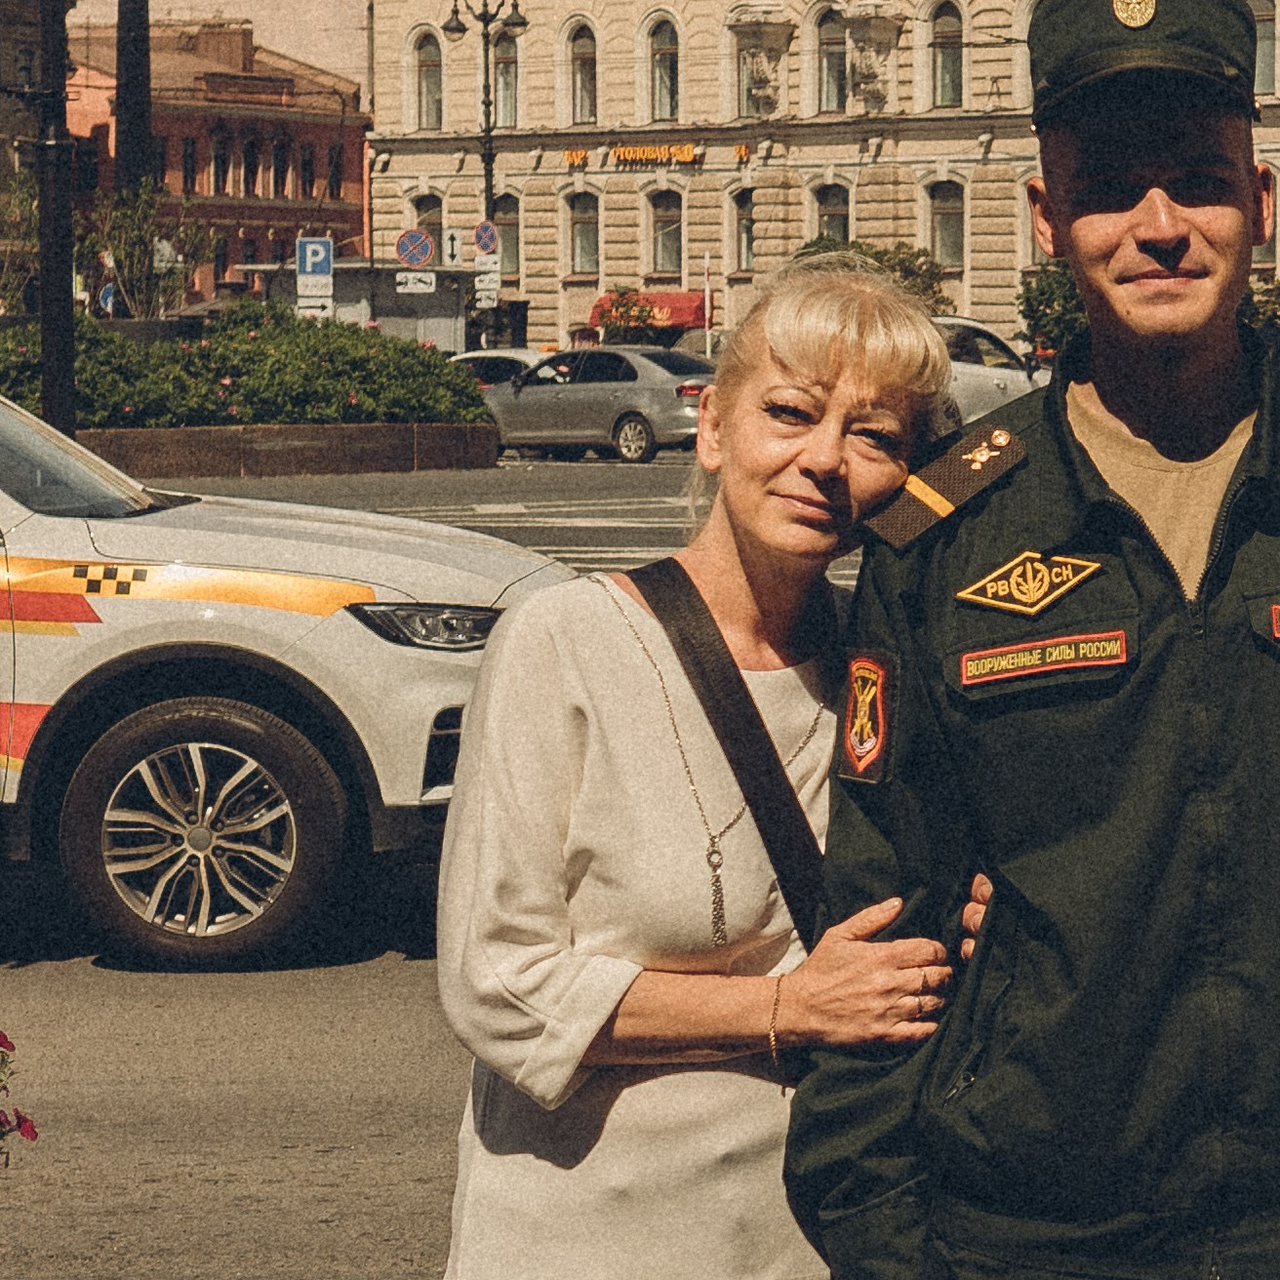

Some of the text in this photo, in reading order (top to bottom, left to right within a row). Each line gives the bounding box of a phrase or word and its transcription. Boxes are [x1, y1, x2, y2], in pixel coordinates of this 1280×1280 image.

[612, 145, 670, 160] СТОЛОВАЯ
[305, 244, 326, 273] P
[986, 564, 1073, 598] РВ СН
[967, 640, 1121, 677] ВООРУЖЕННЫЕ СИЛЫ РОССИИ
